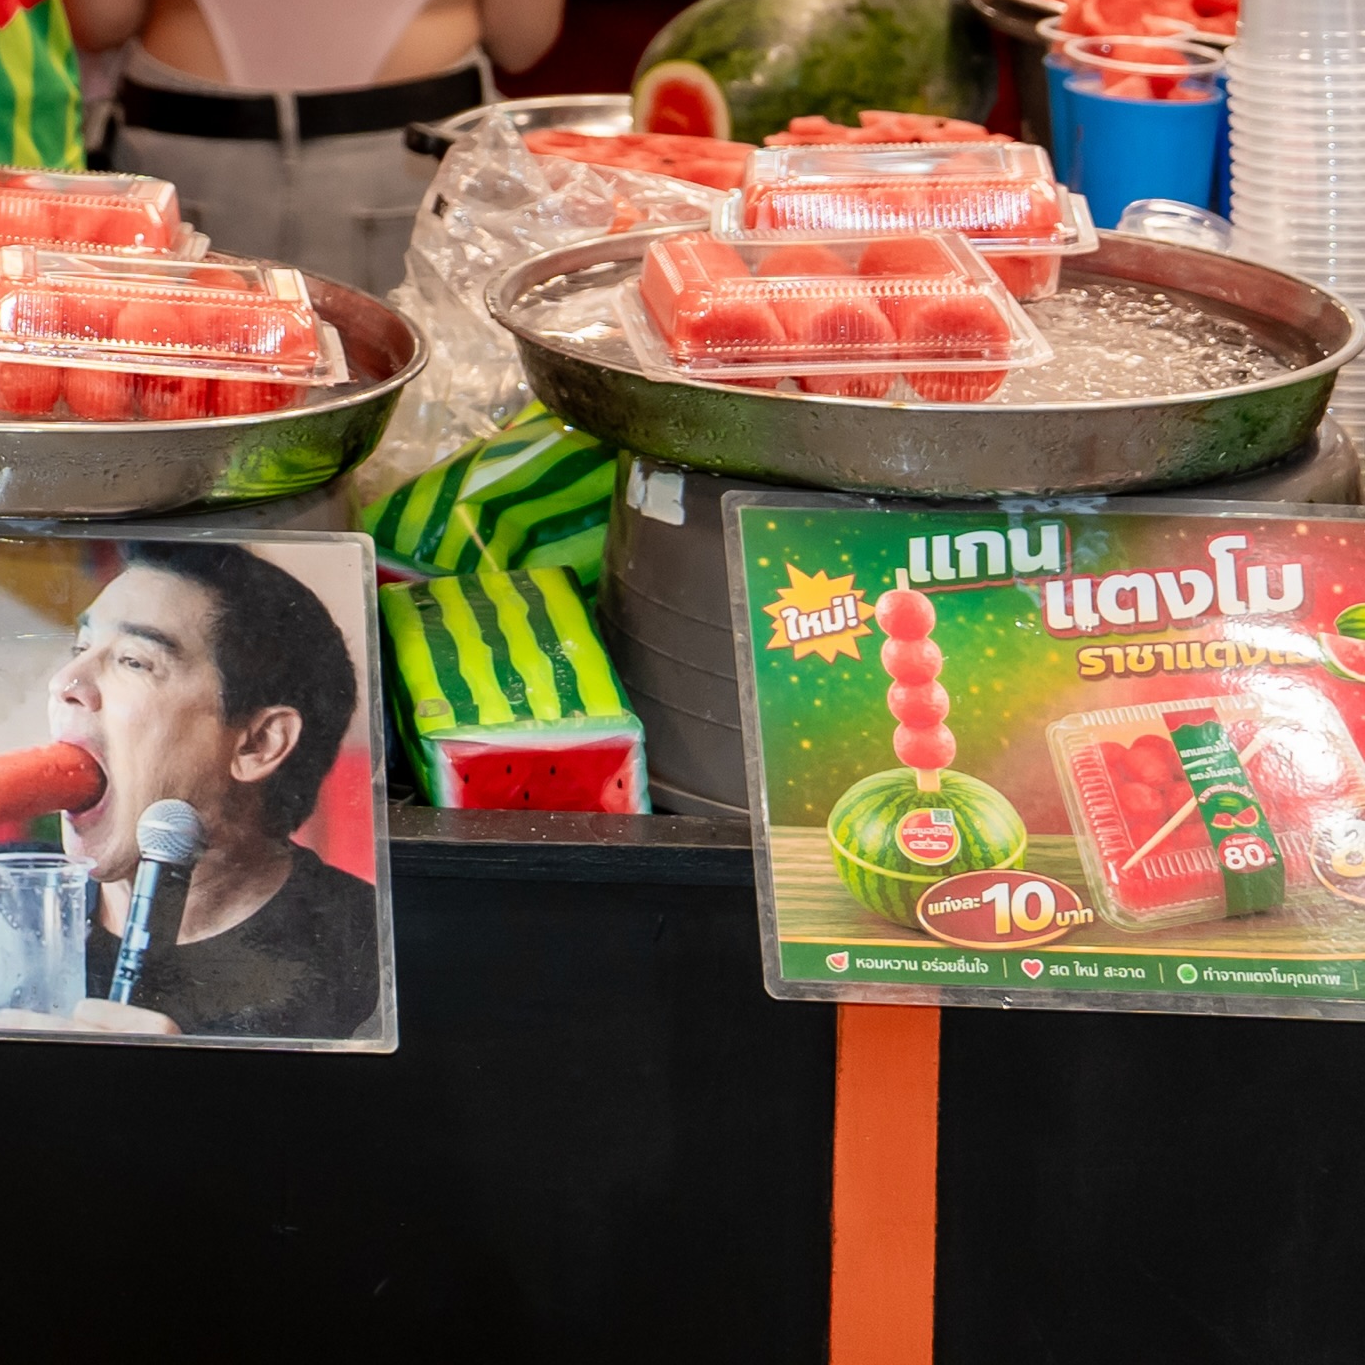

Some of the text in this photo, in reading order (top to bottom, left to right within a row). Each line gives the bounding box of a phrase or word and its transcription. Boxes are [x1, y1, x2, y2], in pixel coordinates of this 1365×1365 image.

[908, 523, 1062, 584] แกน
[1043, 535, 1304, 630] แตงโม
[780, 594, 857, 642] ใหม่!
[927, 880, 1094, 935] แท่งละ 10 บาท
[855, 954, 989, 974] หอมหวาน อร่อยชื่นใจ
[1049, 960, 1146, 980] สด ใหม่ สะอาด
[1203, 967, 1341, 988] ทำจากแตงโมคุณภาพ
